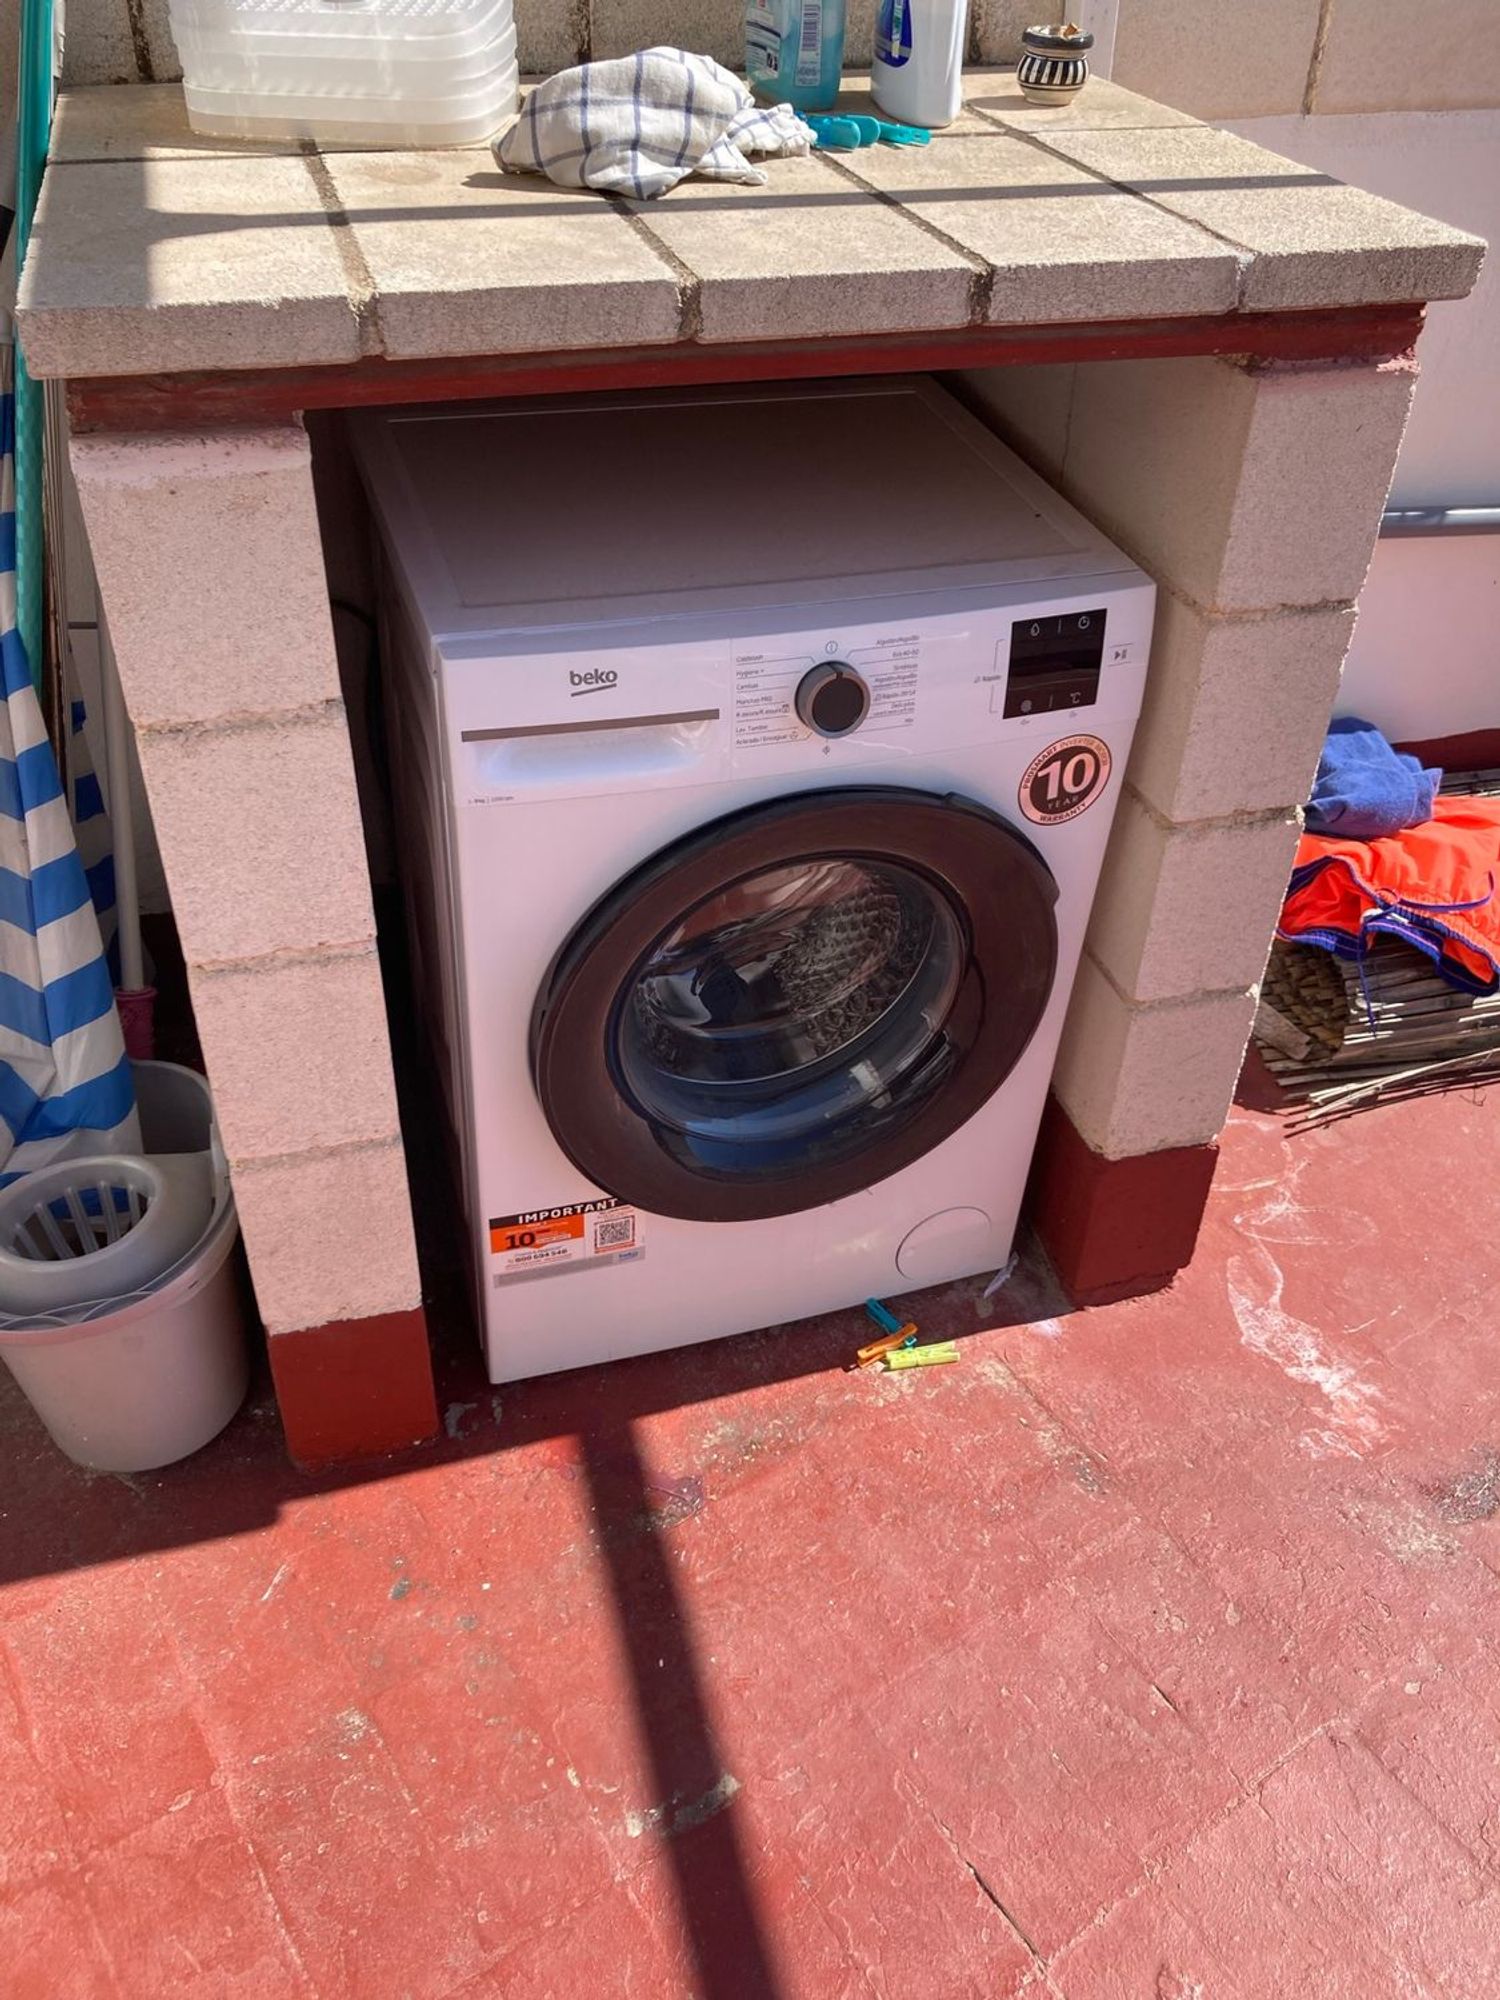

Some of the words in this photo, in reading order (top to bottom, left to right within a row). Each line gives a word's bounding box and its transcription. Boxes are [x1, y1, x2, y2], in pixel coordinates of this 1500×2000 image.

[569, 668, 618, 686] beko
[1023, 746, 1057, 789] PROSMART
[1038, 753, 1096, 800] 10
[1040, 802, 1086, 821] WARRANTY
[1048, 795, 1079, 809] YEAR
[519, 1198, 618, 1224] IMPORTANT
[505, 1232, 536, 1250] 10
